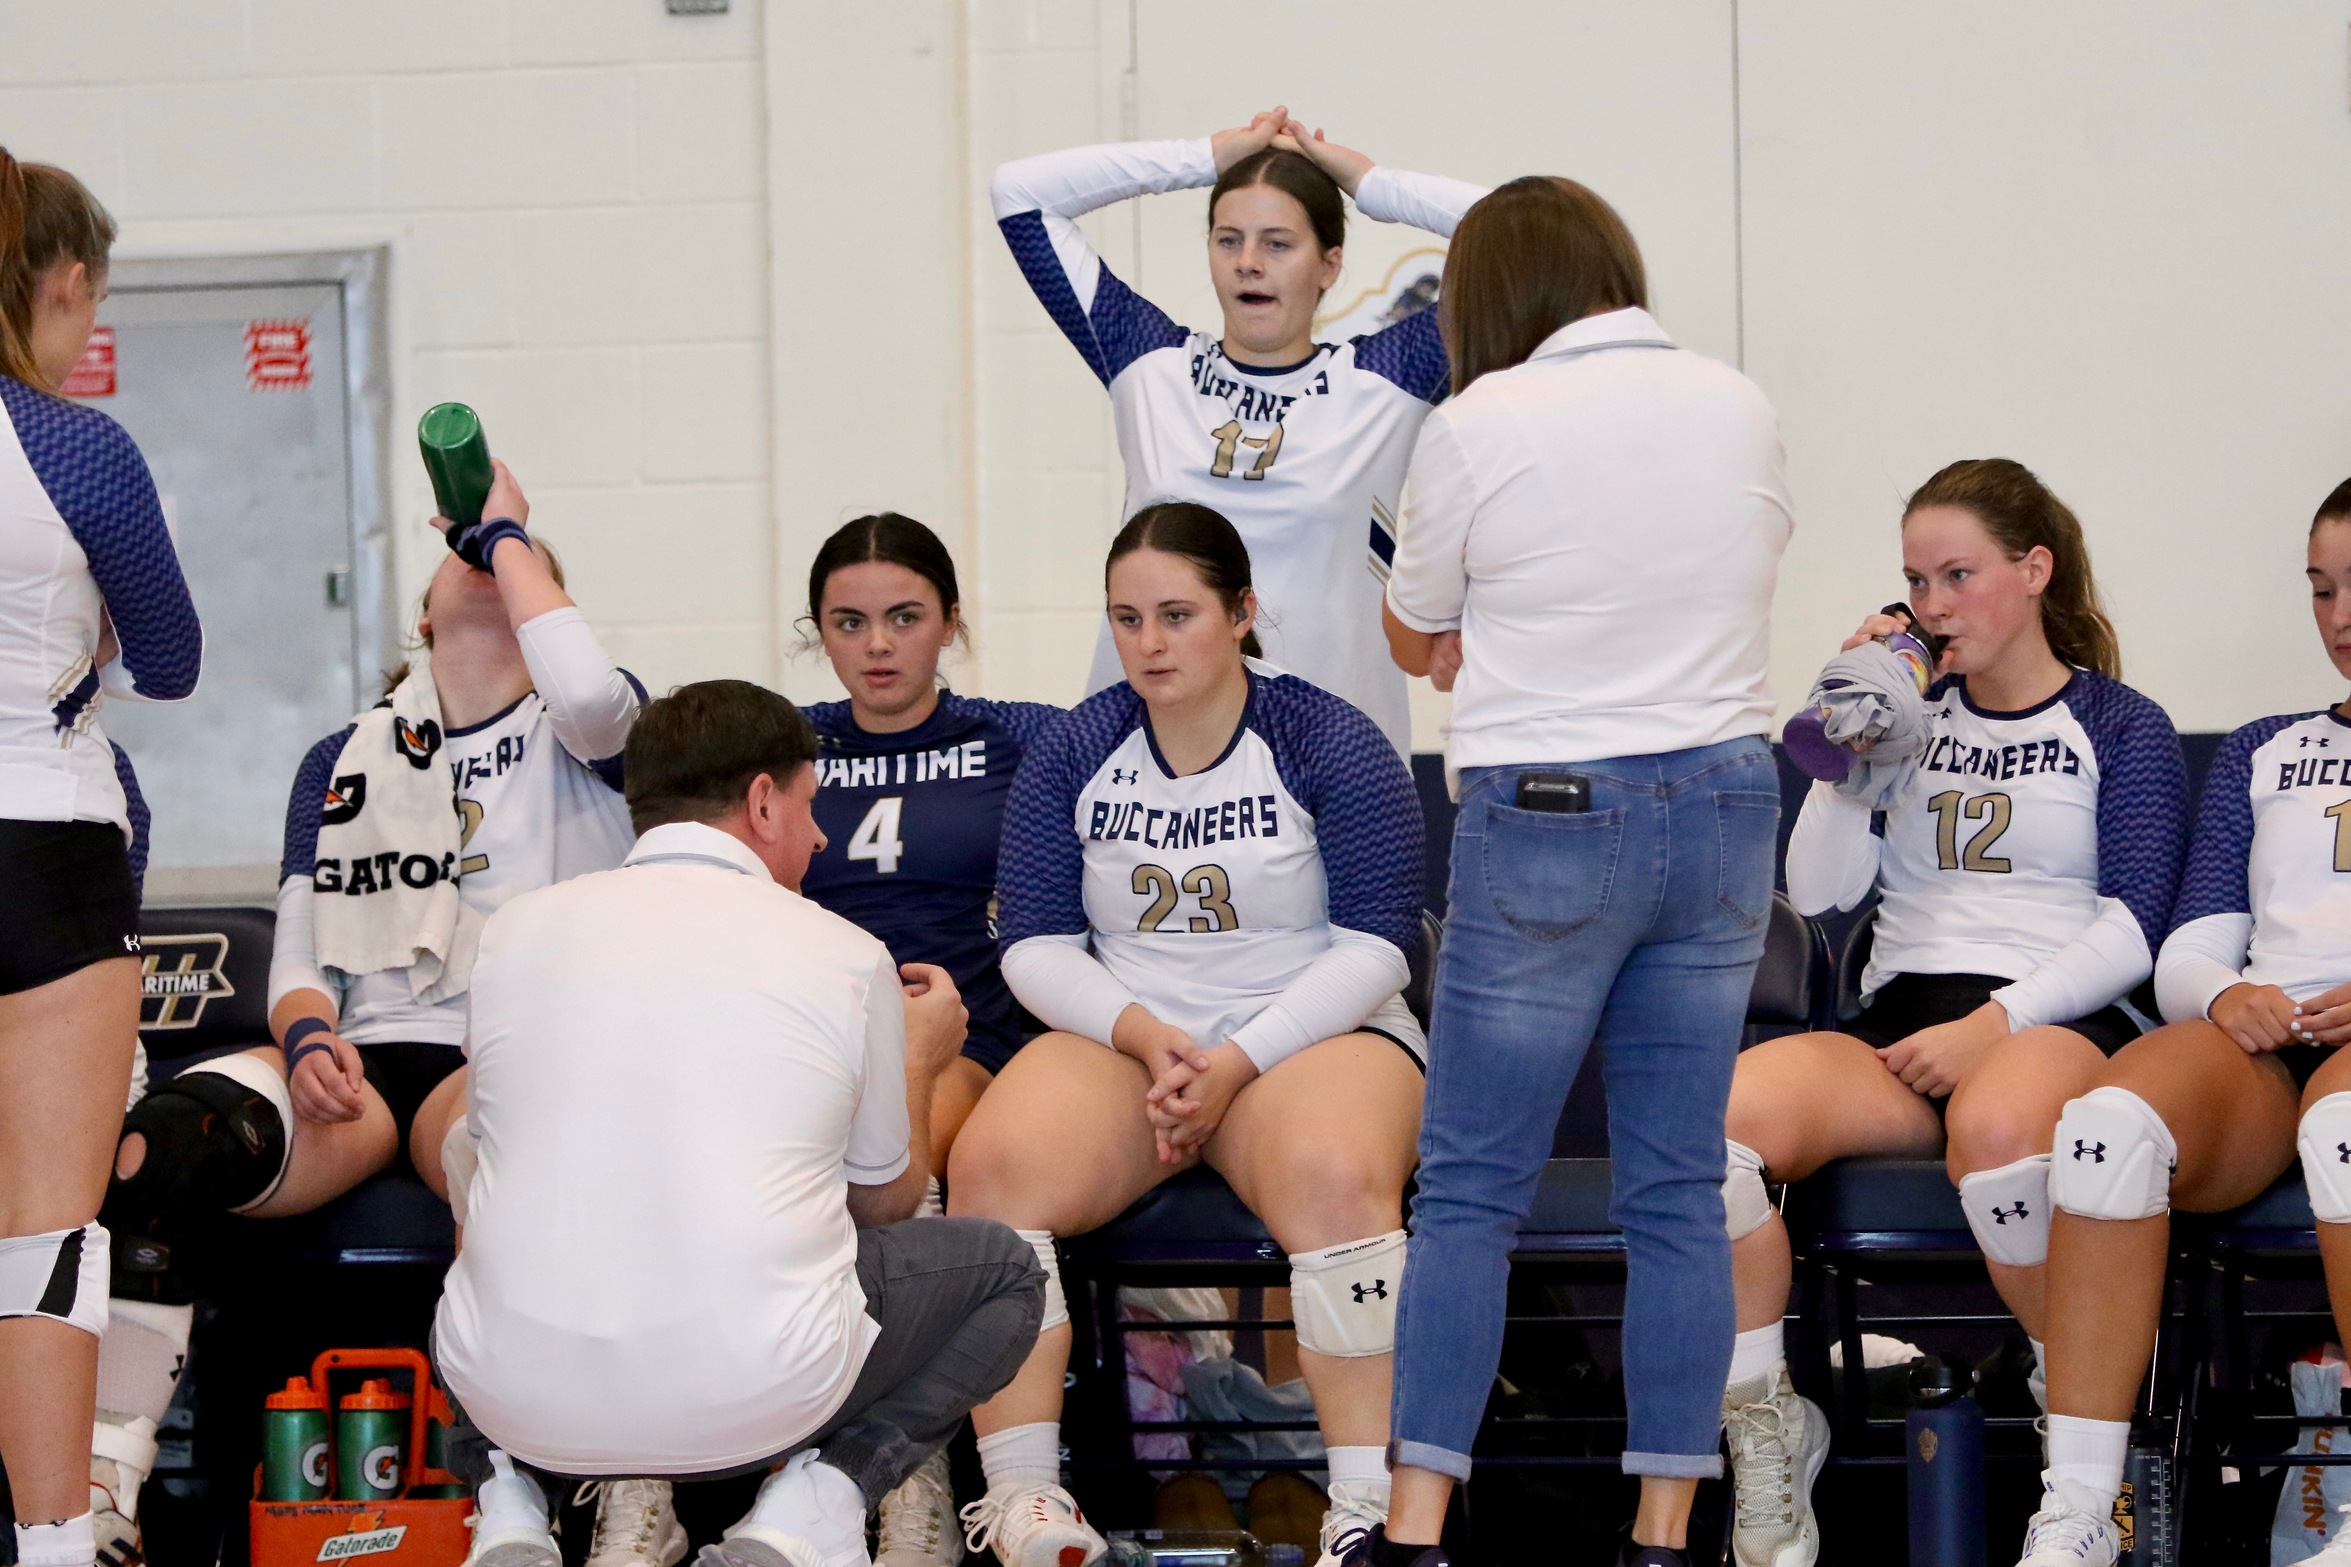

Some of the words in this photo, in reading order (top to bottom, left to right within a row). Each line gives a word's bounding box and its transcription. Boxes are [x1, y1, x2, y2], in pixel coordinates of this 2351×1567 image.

[1210, 419, 1285, 481] 17
[847, 796, 903, 874] 4
[1089, 795, 1278, 849] BUCCANEERS
[1927, 789, 2012, 874] 12
[1132, 863, 1239, 933] 23
[1323, 1248, 1353, 1259] UNDER
[1353, 1238, 1387, 1252] ARMOUR
[363, 1445, 399, 1490] G
[322, 1531, 398, 1558] Gatorade
